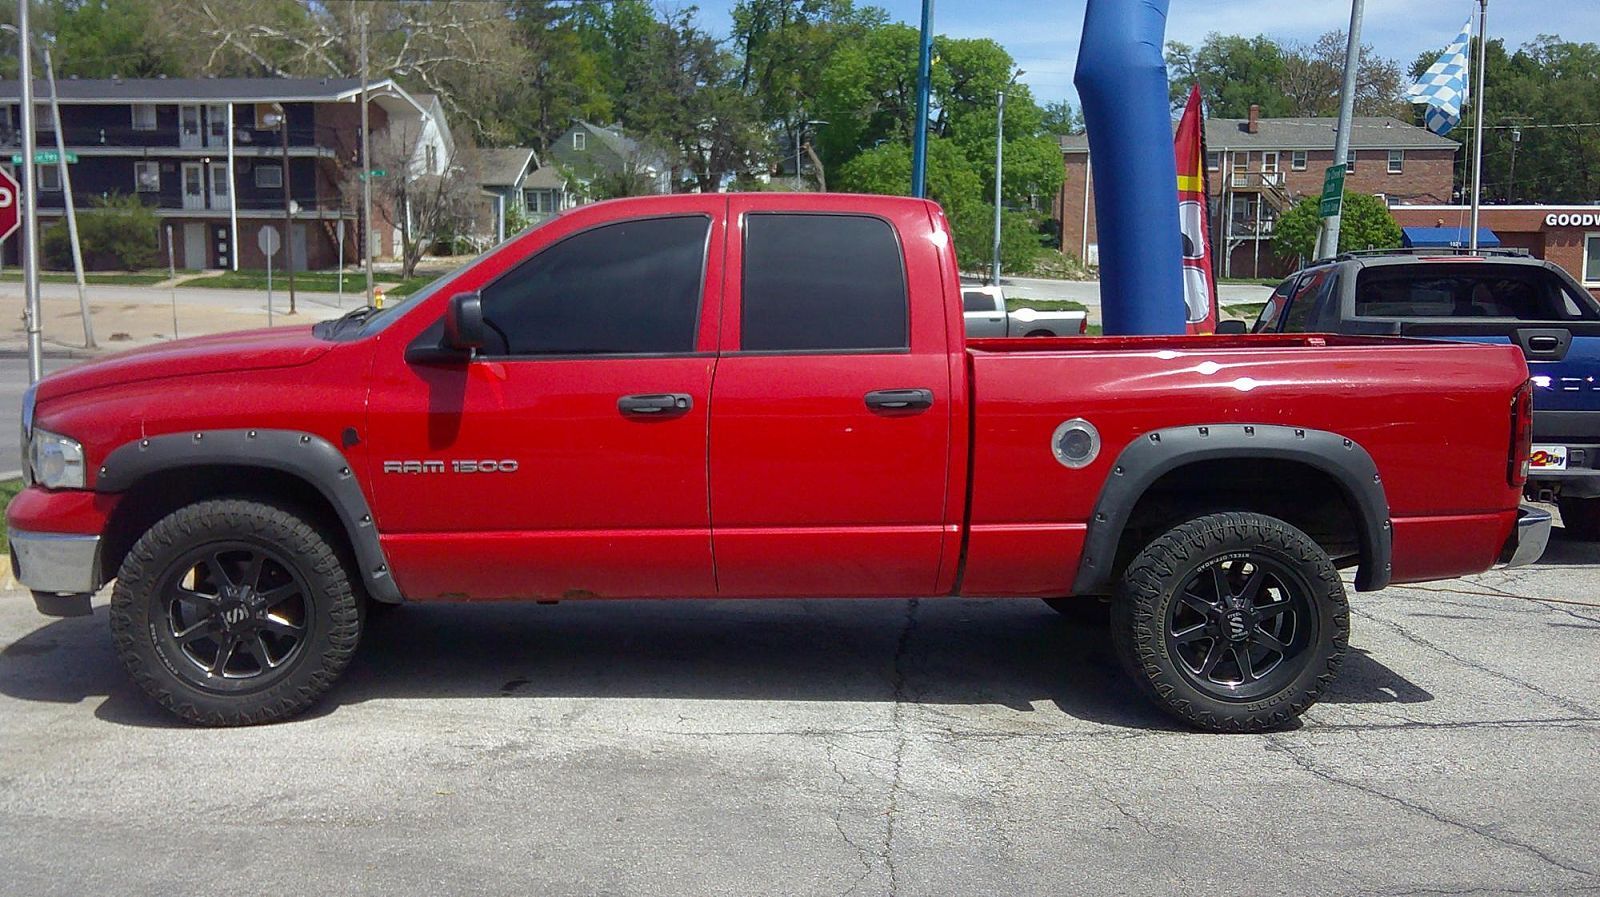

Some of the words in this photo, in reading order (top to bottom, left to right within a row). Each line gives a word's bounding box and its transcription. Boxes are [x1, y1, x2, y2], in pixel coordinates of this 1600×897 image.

[1529, 450, 1565, 466] 2Day
[384, 460, 445, 474] RAM
[452, 459, 519, 473] 1500
